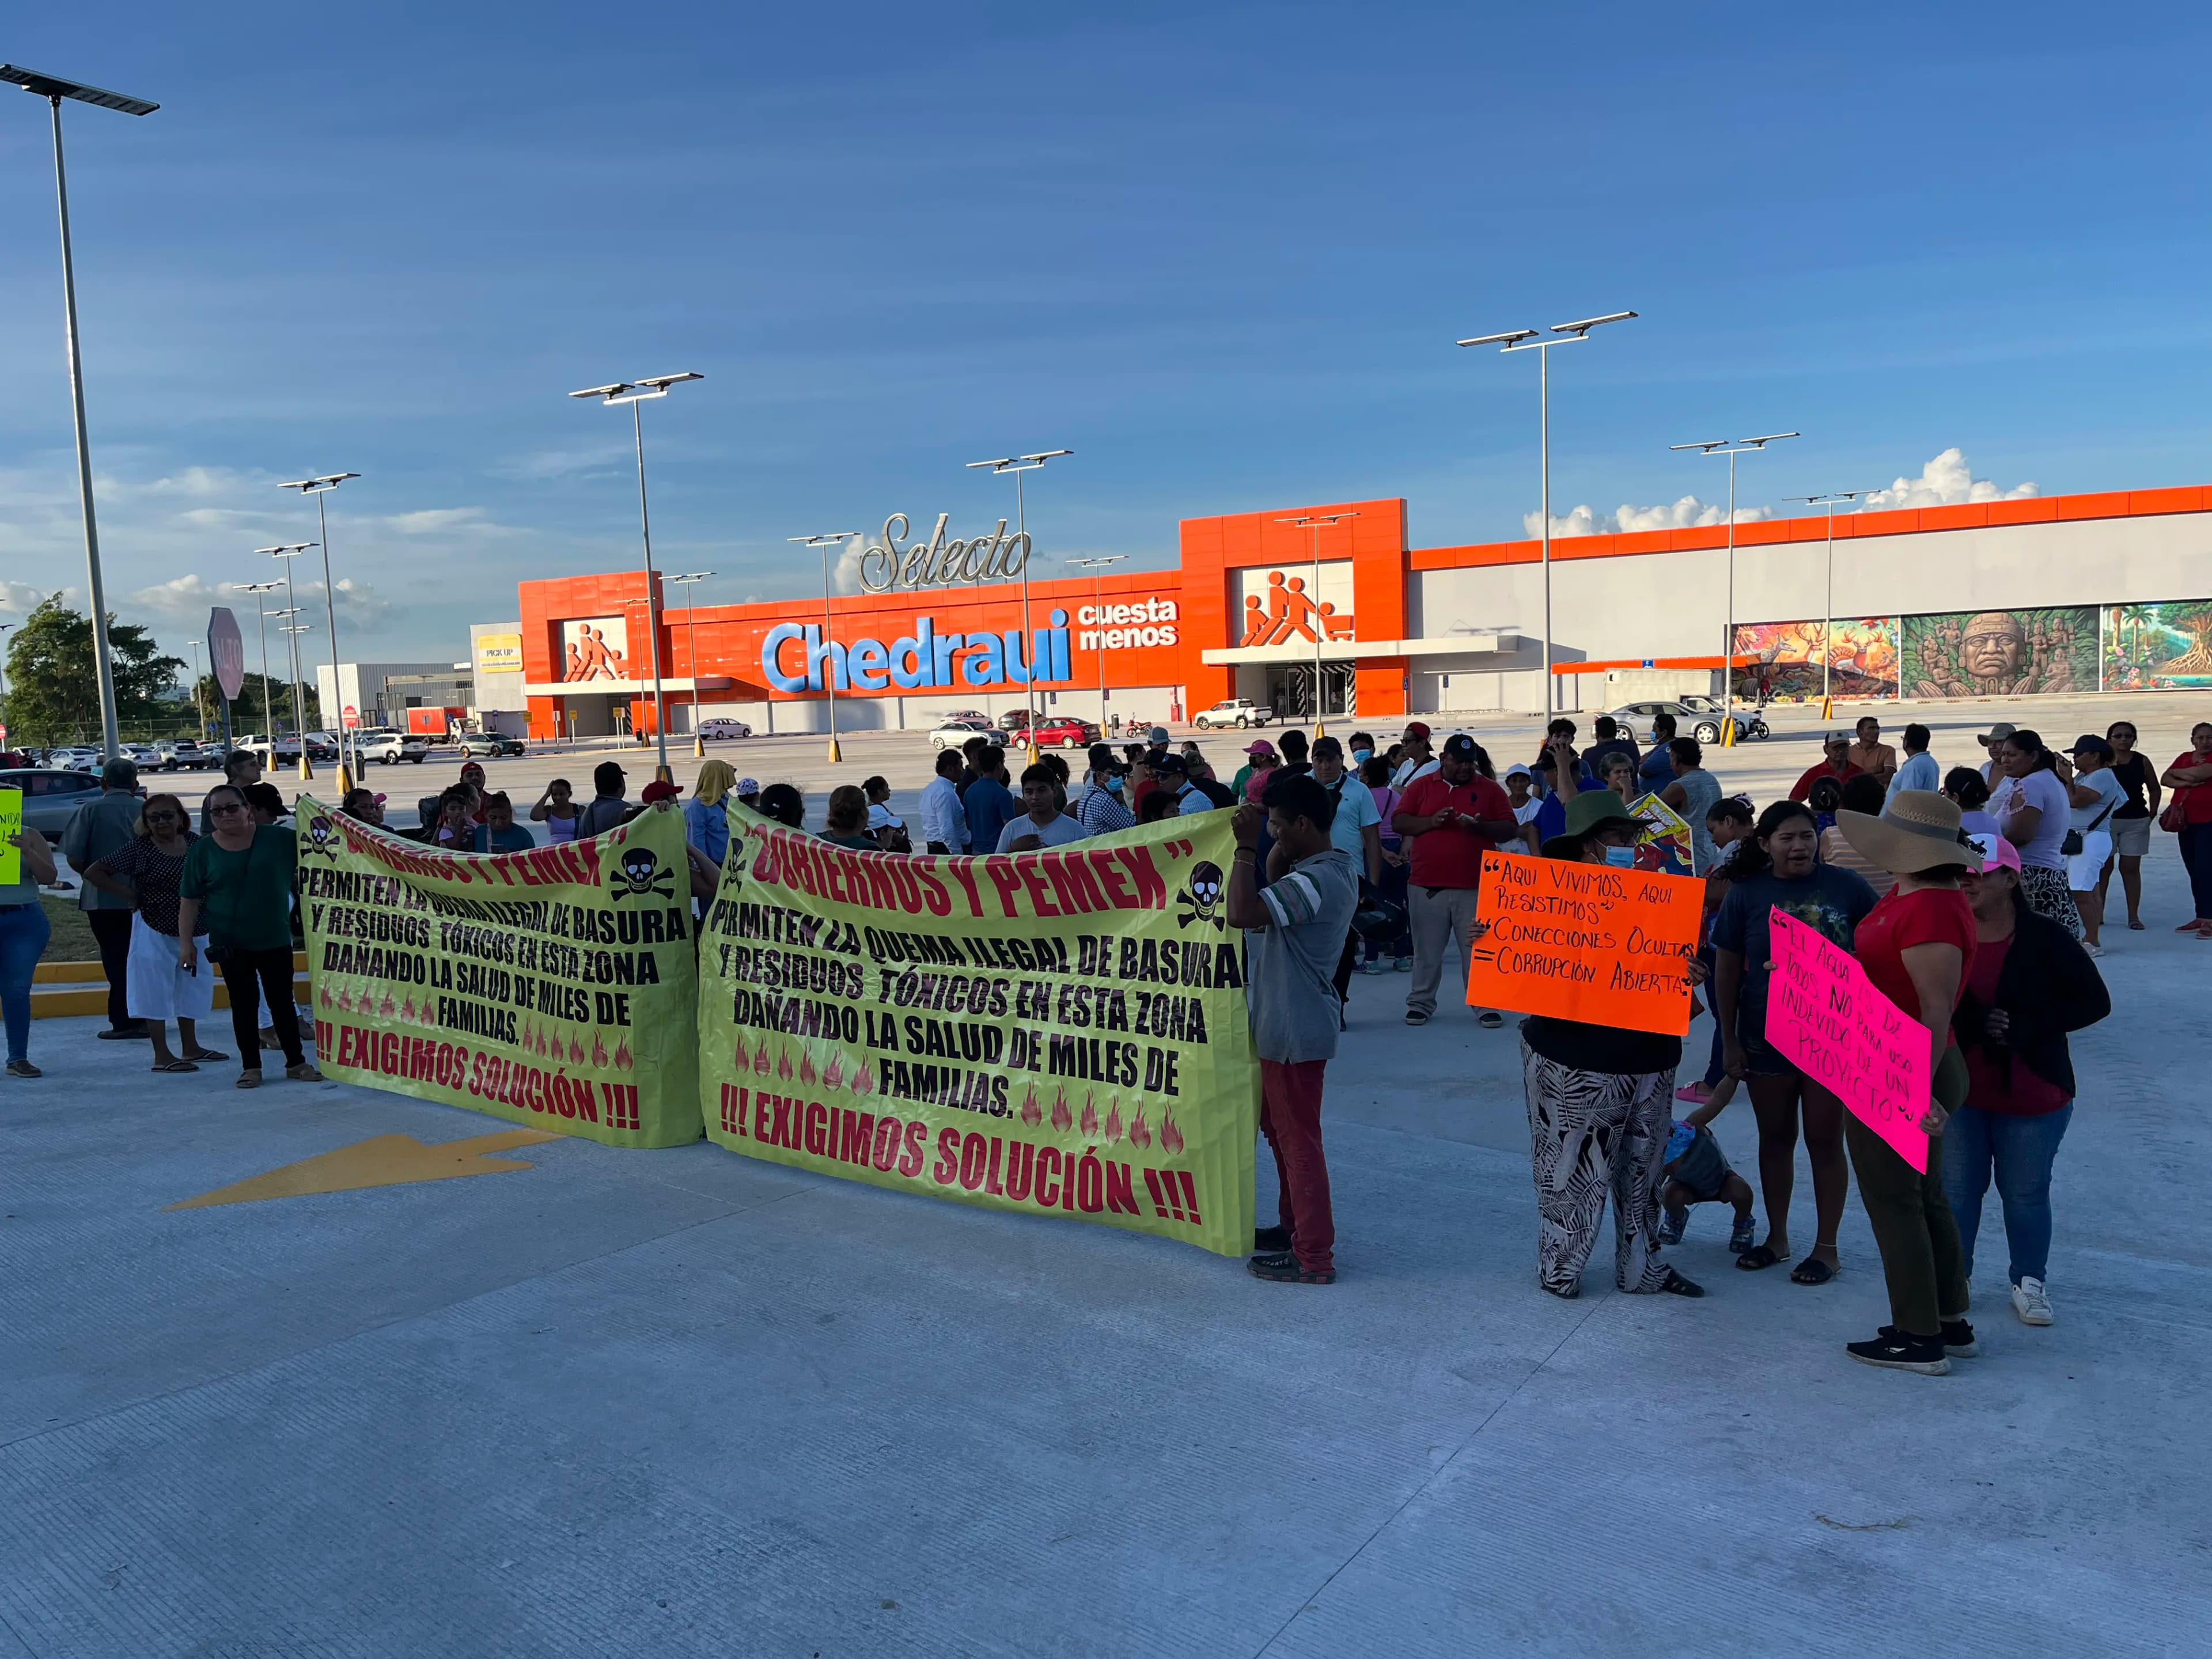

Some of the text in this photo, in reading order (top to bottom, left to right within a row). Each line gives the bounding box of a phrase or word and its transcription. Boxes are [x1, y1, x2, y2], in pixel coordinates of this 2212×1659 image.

[859, 513, 1032, 593] Selecto
[762, 608, 1071, 692] Chedraui
[1078, 597, 1177, 625] cuesta
[1080, 625, 1177, 650] menos
[215, 638, 241, 670] ALTO
[487, 649, 502, 657] PICK
[298, 866, 400, 907] PERMITEN
[403, 880, 427, 911] LA
[483, 901, 549, 933] ILEGAL
[551, 902, 570, 938] DE
[573, 906, 687, 945] BASURA
[948, 856, 984, 917] Y
[986, 845, 1166, 918] PEMEX
[1638, 882, 1672, 904] AQUI
[311, 903, 660, 986] Y RESIDUOS TÓXICOS EN ESTA ZONA
[710, 899, 1243, 989] PERMITEN LA QUEMA ILEGAL DE BASURA
[1627, 926, 1695, 958] OCULTAS
[323, 940, 631, 1027] DAÑANDO LA SALUD DE MILES DE
[438, 995, 520, 1046] FAMILIAS.
[719, 943, 1208, 1044] Y RESIDUOS TÓXICOS EN ESTA ZONA
[1816, 941, 1849, 984] AGUA
[1858, 982, 1873, 1014] ES
[1882, 1004, 1902, 1040] DE
[733, 987, 1179, 1096] DAÑANDO LA SALUD DE MILES DE
[1781, 981, 1910, 1101] INDEVIDO DE UN
[1829, 984, 1853, 1018] NO
[1857, 1010, 1883, 1054] PARA
[1889, 1048, 1912, 1074] USO
[337, 1025, 468, 1090] EXIGIMOS
[468, 1051, 599, 1123] SOLUCIÓN
[878, 1058, 1013, 1119] FAMILIAS.
[755, 1091, 927, 1177] EXIGIMOS
[933, 1127, 1141, 1216] SOLUCIÓN
